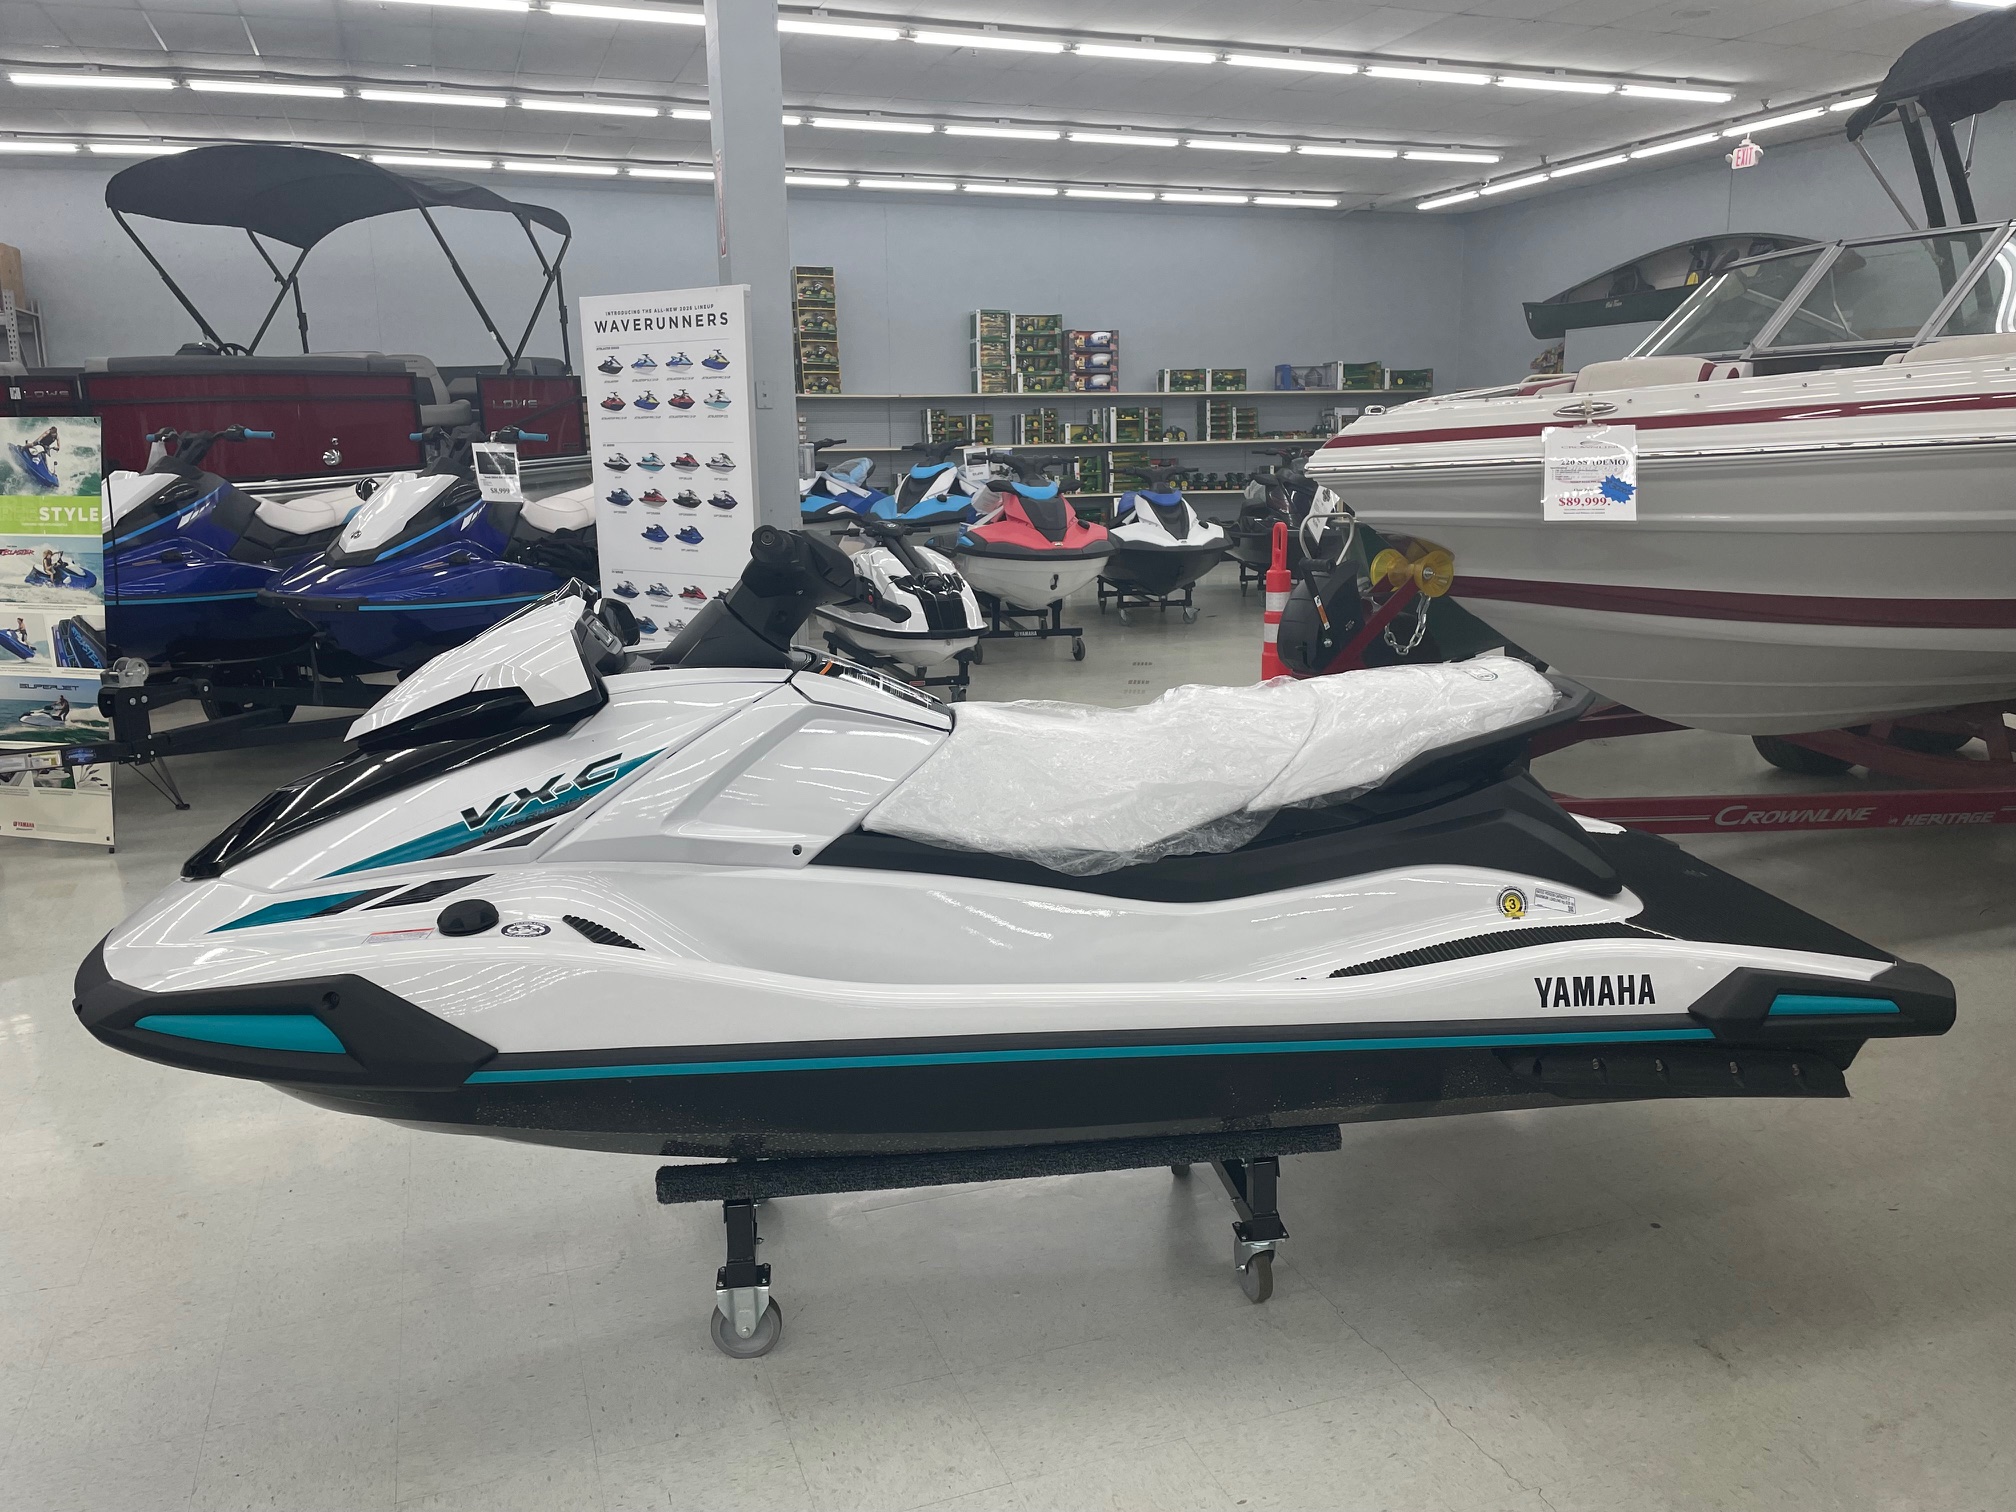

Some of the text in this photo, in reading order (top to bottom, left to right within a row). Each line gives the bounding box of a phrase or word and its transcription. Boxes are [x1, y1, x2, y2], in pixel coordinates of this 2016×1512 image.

[1735, 147, 1753, 167] EXIT
[594, 312, 728, 333] WAVERUNNERS
[39, 506, 99, 522] STYLE
[19, 683, 79, 691] SUPERJET
[1714, 805, 1877, 826] CROWNLINE
[1901, 811, 1996, 826] HERITAGE
[1508, 898, 1516, 910] 3
[1534, 974, 1656, 1008] YAMAHA
